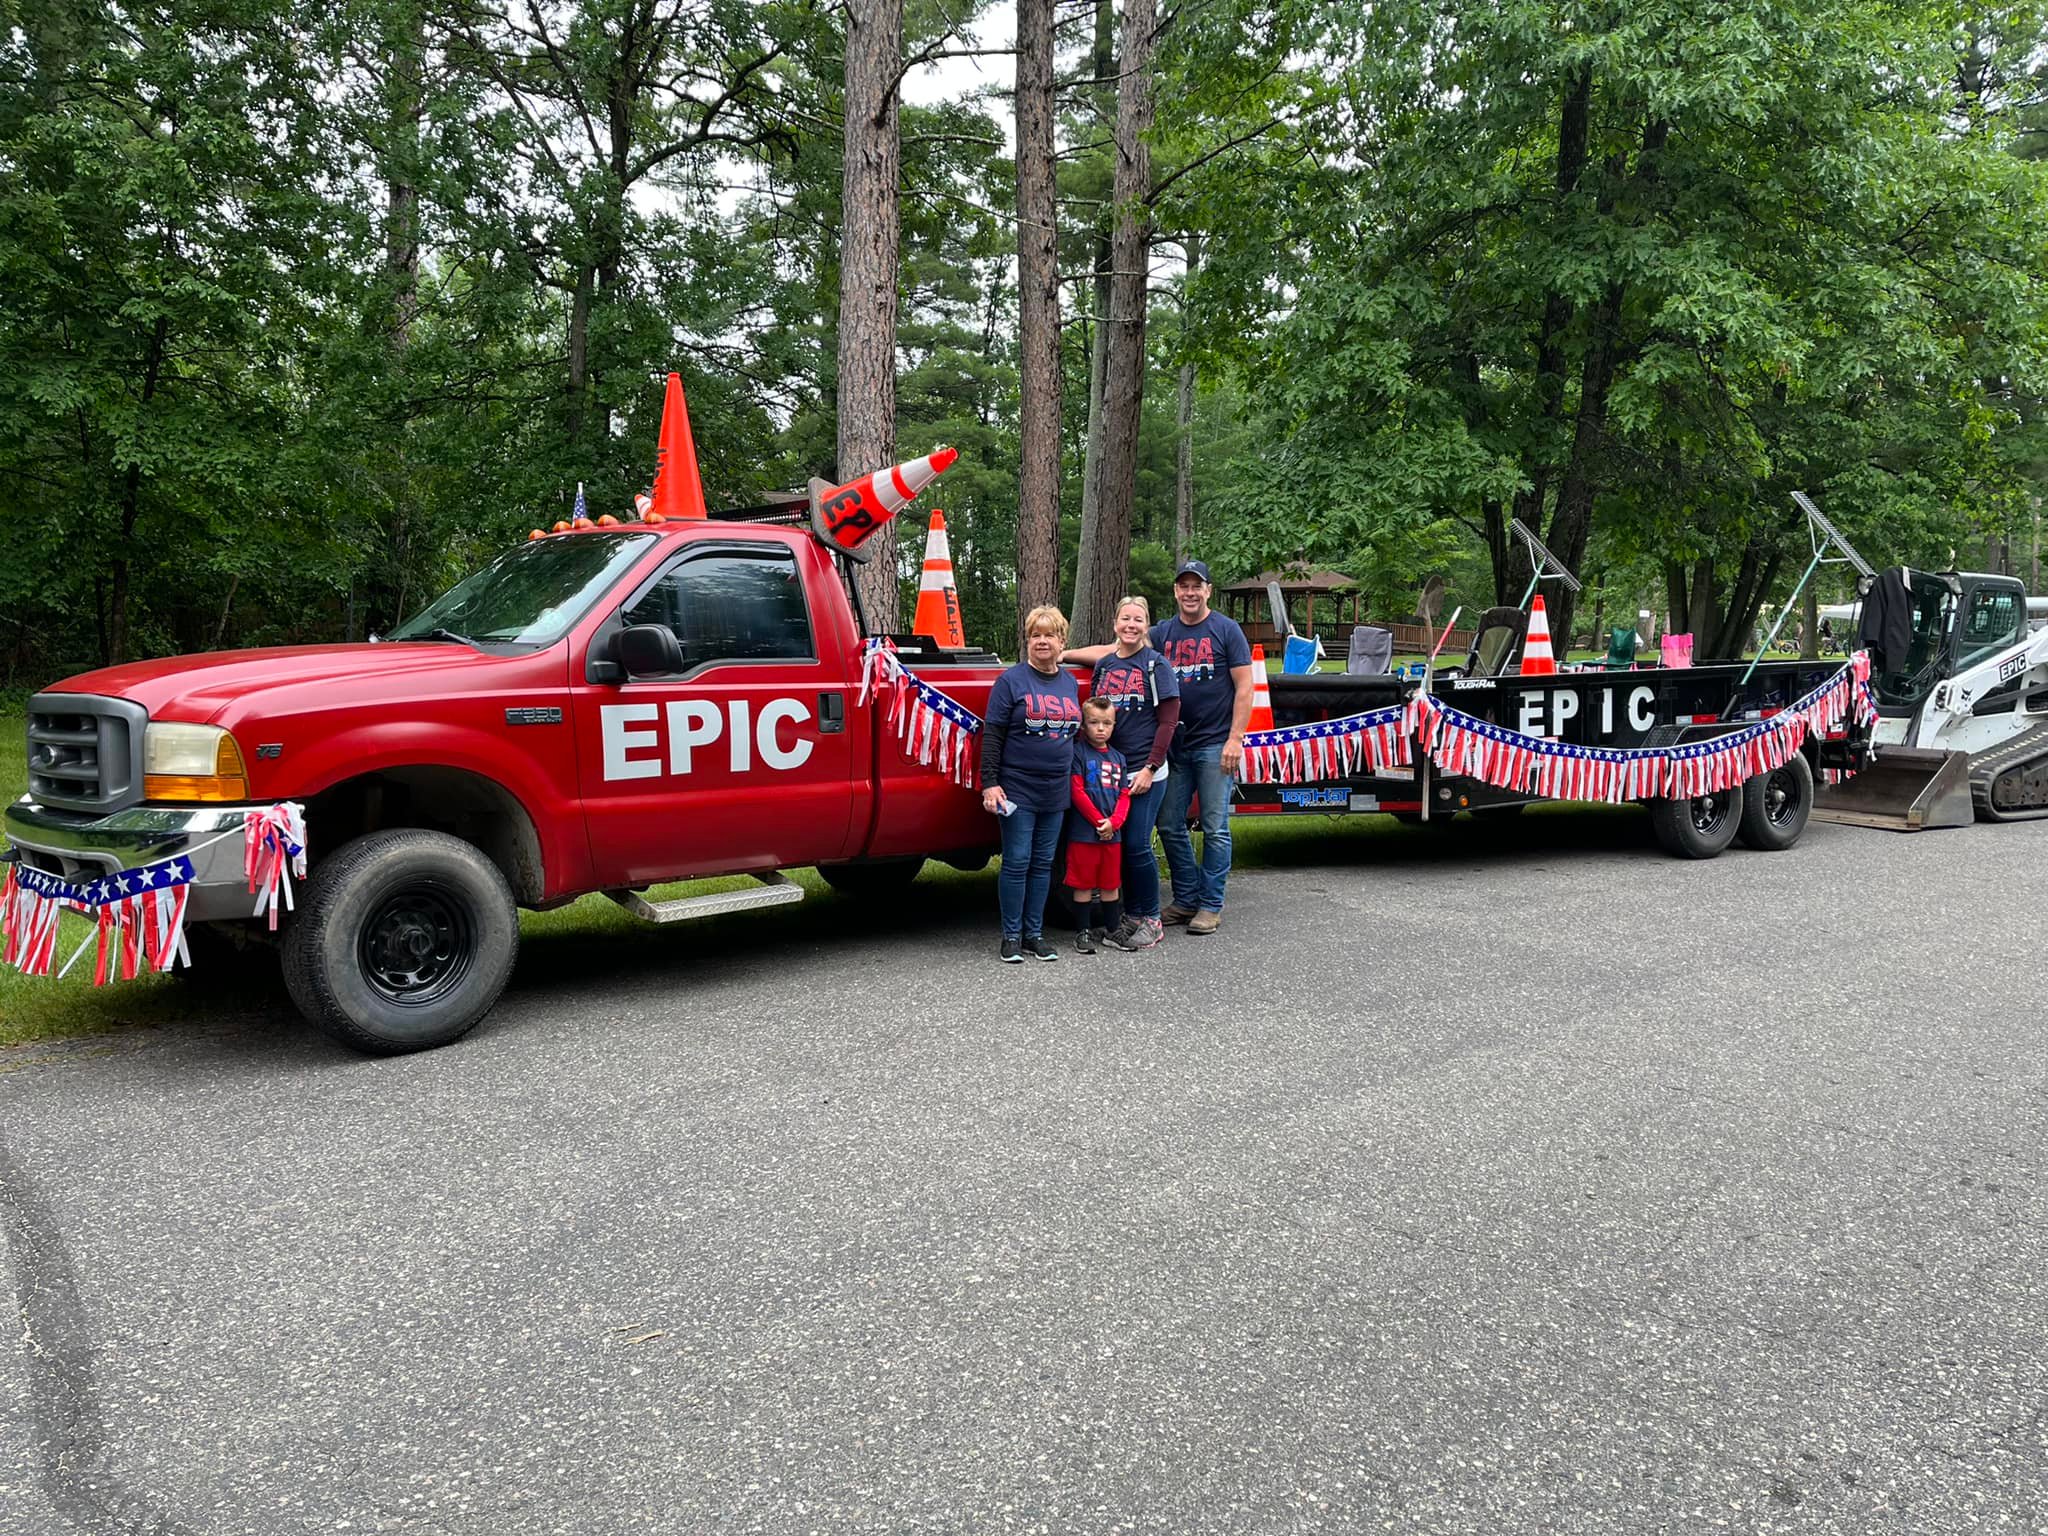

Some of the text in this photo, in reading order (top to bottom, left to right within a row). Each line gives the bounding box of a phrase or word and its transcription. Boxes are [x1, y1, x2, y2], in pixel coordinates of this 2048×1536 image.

[1164, 637, 1215, 667] USA
[2000, 655, 2026, 679] EPIC
[1025, 694, 1082, 722] USA
[1519, 686, 1655, 737] EPIC
[600, 698, 814, 782] EPIC
